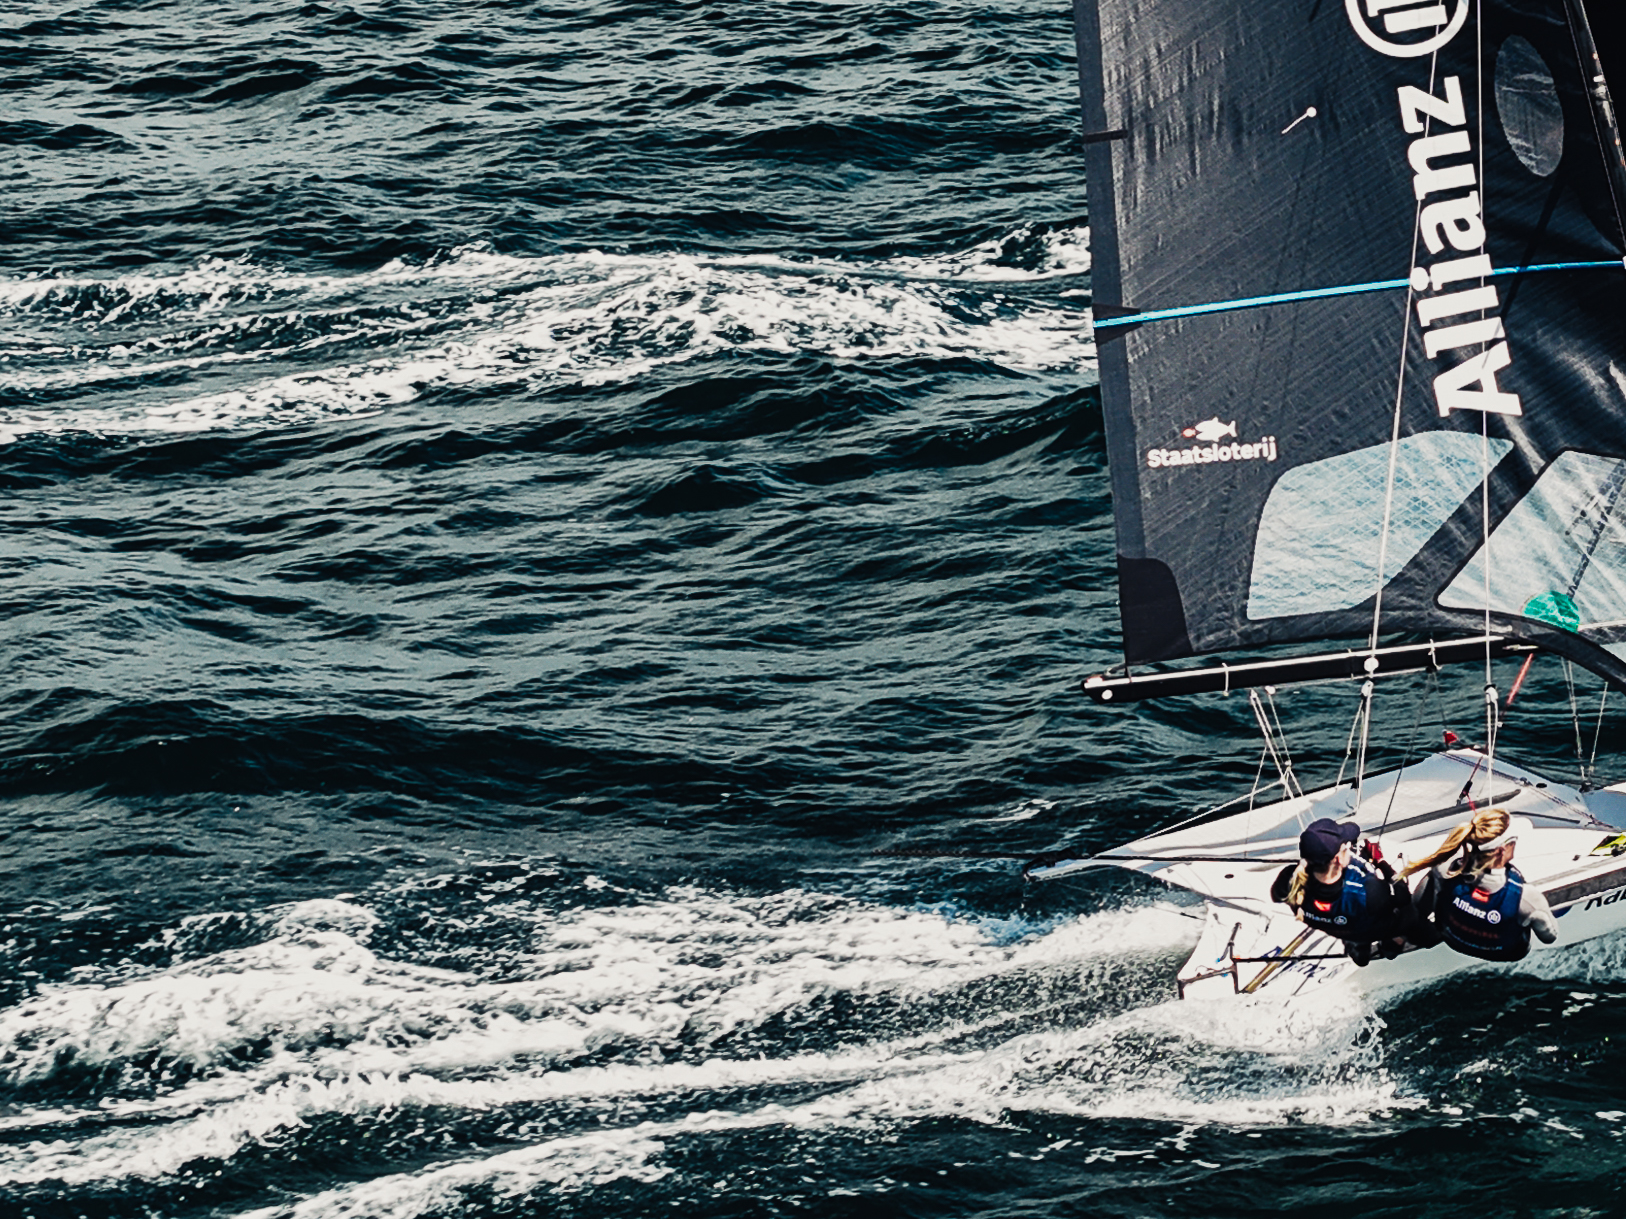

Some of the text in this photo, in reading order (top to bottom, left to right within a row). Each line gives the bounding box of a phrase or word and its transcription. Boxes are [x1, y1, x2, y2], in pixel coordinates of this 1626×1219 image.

[1396, 75, 1523, 418] Allianz
[1147, 435, 1278, 468] Staatsloterij
[1452, 896, 1487, 920] Allianz
